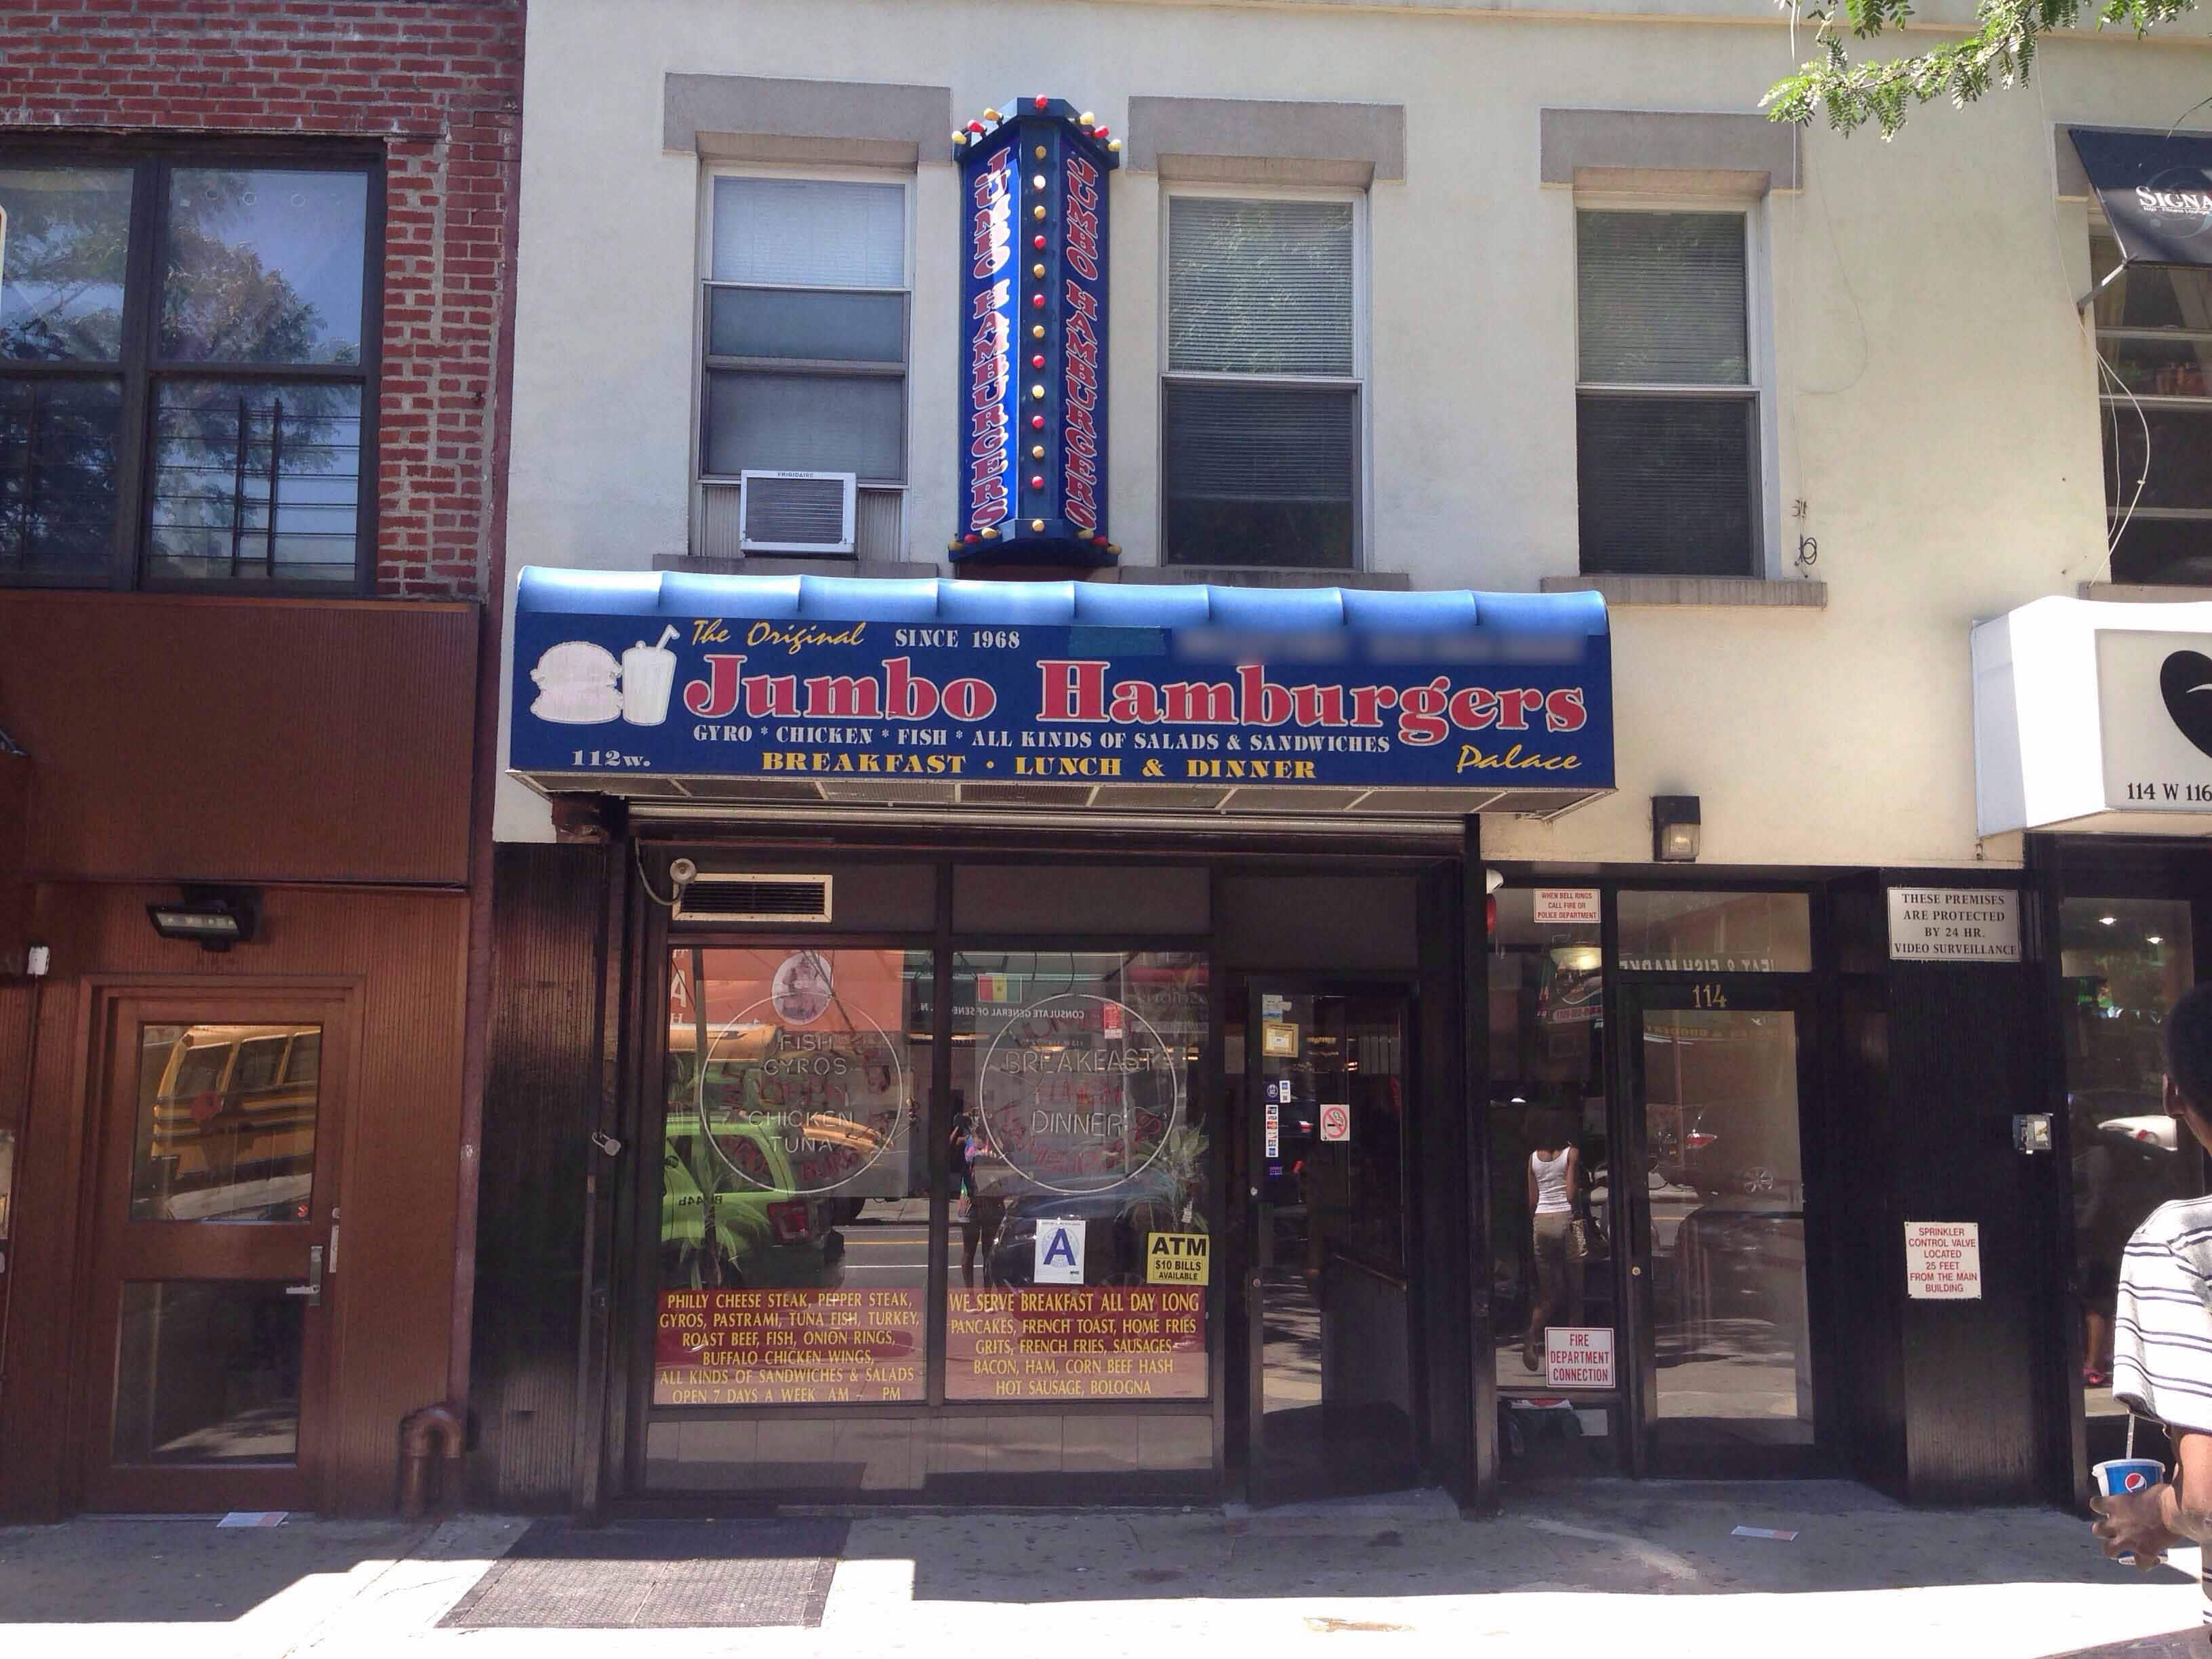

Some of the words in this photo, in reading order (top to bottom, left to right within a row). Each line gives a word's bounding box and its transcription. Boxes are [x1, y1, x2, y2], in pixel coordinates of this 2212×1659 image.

[973, 146, 1011, 279] JUMBO
[1066, 157, 1099, 281] JUMBO
[970, 279, 1011, 531] HAMBURGERS
[1065, 279, 1099, 531] HAMBURGERS
[691, 618, 731, 647] The
[747, 621, 867, 655] Original
[895, 628, 959, 649] SINCE
[971, 629, 1020, 649] 1968
[683, 654, 997, 722] Jumbo
[1036, 659, 1587, 747] Hamburgers
[693, 724, 753, 743] GYRO
[775, 726, 874, 745] CHICKEN
[897, 728, 947, 746] FISH
[972, 730, 1012, 747] ALL
[1021, 731, 1092, 750] KINDS
[1100, 731, 1127, 750] OF
[1133, 732, 1219, 751] SALADS
[1227, 734, 1241, 751] &
[1250, 735, 1390, 753] SANDWICHES
[571, 750, 651, 768] 112w.
[762, 752, 966, 773] BREAKFAST
[1015, 757, 1122, 777] LUNCH
[1143, 758, 1165, 777] &
[1187, 759, 1316, 779] DINNER
[1456, 743, 1582, 774] Palace
[2128, 782, 2156, 800] 114
[2163, 783, 2179, 800] W
[2186, 784, 2212, 802] 116
[1902, 894, 1941, 904] THESE
[1946, 895, 2005, 905] PREMISES
[1903, 910, 1929, 920] ARE
[1933, 911, 2005, 922] PROTECTED
[1925, 927, 1940, 937] BY
[1946, 927, 1959, 937] 24
[1964, 928, 1985, 938] HR.
[1894, 943, 1930, 954] VIDEO
[1933, 943, 2017, 955] SURVEILLANCE
[1692, 984, 1727, 1008] 114
[780, 1034, 834, 1050] FISH
[764, 1057, 846, 1076] GYROS
[1004, 1048, 1155, 1073] BREAKFAST
[748, 1110, 854, 1128] CHICKEN
[1031, 1109, 1124, 1136] DINNER
[770, 1136, 833, 1154] TUNA
[1919, 1227, 1965, 1236] SPRINKLER
[1043, 1228, 1076, 1266] A
[1152, 1236, 1206, 1256] ATM
[1908, 1238, 1949, 1247] CONTROL
[1952, 1239, 1976, 1247] VALVE
[1924, 1250, 1962, 1258] LOCATED
[1155, 1260, 1172, 1271] $10
[1174, 1261, 1201, 1271] BILLS
[1926, 1262, 1936, 1270] 25
[1940, 1262, 1960, 1270] FEET
[1158, 1271, 1198, 1280] AVAILABLE
[1910, 1273, 1934, 1281] FROM
[1938, 1273, 1953, 1281] THE
[1957, 1273, 1978, 1281] MAIN
[1925, 1284, 1963, 1292] BUILDING
[668, 1294, 709, 1309] PHILLY
[716, 1294, 761, 1308] CHEESE
[768, 1293, 812, 1310] STEAK,
[818, 1293, 862, 1308] PEPPER
[869, 1292, 913, 1309] STEAK,
[949, 1293, 970, 1312] WE
[976, 1293, 1014, 1312] SERVE
[1021, 1293, 1094, 1312] BREAKFAST
[1101, 1293, 1124, 1312] ALL
[1130, 1293, 1156, 1311] DAY
[1162, 1293, 1199, 1311] LONG
[659, 1313, 708, 1329] GYROS,
[714, 1313, 782, 1328] PASTRAMI,
[790, 1312, 824, 1327] TUNA
[830, 1312, 861, 1328] FISH,
[867, 1311, 920, 1328] TURKEY,
[950, 1319, 1017, 1336] PANCAKES,
[1022, 1319, 1071, 1334] FRENCH
[1077, 1319, 1117, 1335] TOAST,
[1122, 1319, 1160, 1334] HOME
[1166, 1319, 1196, 1334] FRIES
[682, 1332, 724, 1347] ROAST
[731, 1331, 759, 1347] BEEF,
[766, 1331, 797, 1347] FISH,
[804, 1330, 847, 1345] ONION
[853, 1330, 896, 1346] RINGS,
[975, 1339, 1014, 1356] GRITS,
[1019, 1339, 1067, 1354] FRENCH
[1073, 1339, 1107, 1355] FRIES,
[1113, 1338, 1172, 1354] SAUSAGES
[1570, 1334, 1589, 1347] FIRE
[703, 1351, 758, 1366] BUFFALO
[764, 1350, 821, 1365] CHICKEN
[828, 1350, 874, 1366] WINGS,
[1551, 1351, 1610, 1364] DEPARTMENT
[660, 1370, 683, 1384] ALL
[690, 1370, 729, 1384] KINDS
[735, 1370, 752, 1383] OF
[759, 1368, 842, 1383] SANDWICHES
[849, 1368, 859, 1382] &
[866, 1368, 914, 1382] SALADS
[974, 1359, 1019, 1376] BACON,
[1025, 1359, 1059, 1376] HAM,
[1065, 1359, 1101, 1374] CORN
[1107, 1359, 1132, 1373] BEEF
[1139, 1359, 1173, 1373] HASH
[1553, 1368, 1608, 1382] CONNECTION
[672, 1389, 707, 1404] OPEN
[714, 1389, 720, 1403] 7
[727, 1389, 758, 1403] DAYS
[765, 1389, 773, 1402] A
[781, 1388, 814, 1401] WEEK
[829, 1388, 848, 1401] AM
[882, 1387, 901, 1401] PM
[996, 1380, 1022, 1395] HOT
[1029, 1380, 1084, 1395] SAUSAGE,
[1090, 1380, 1151, 1394] BOLOGNA
